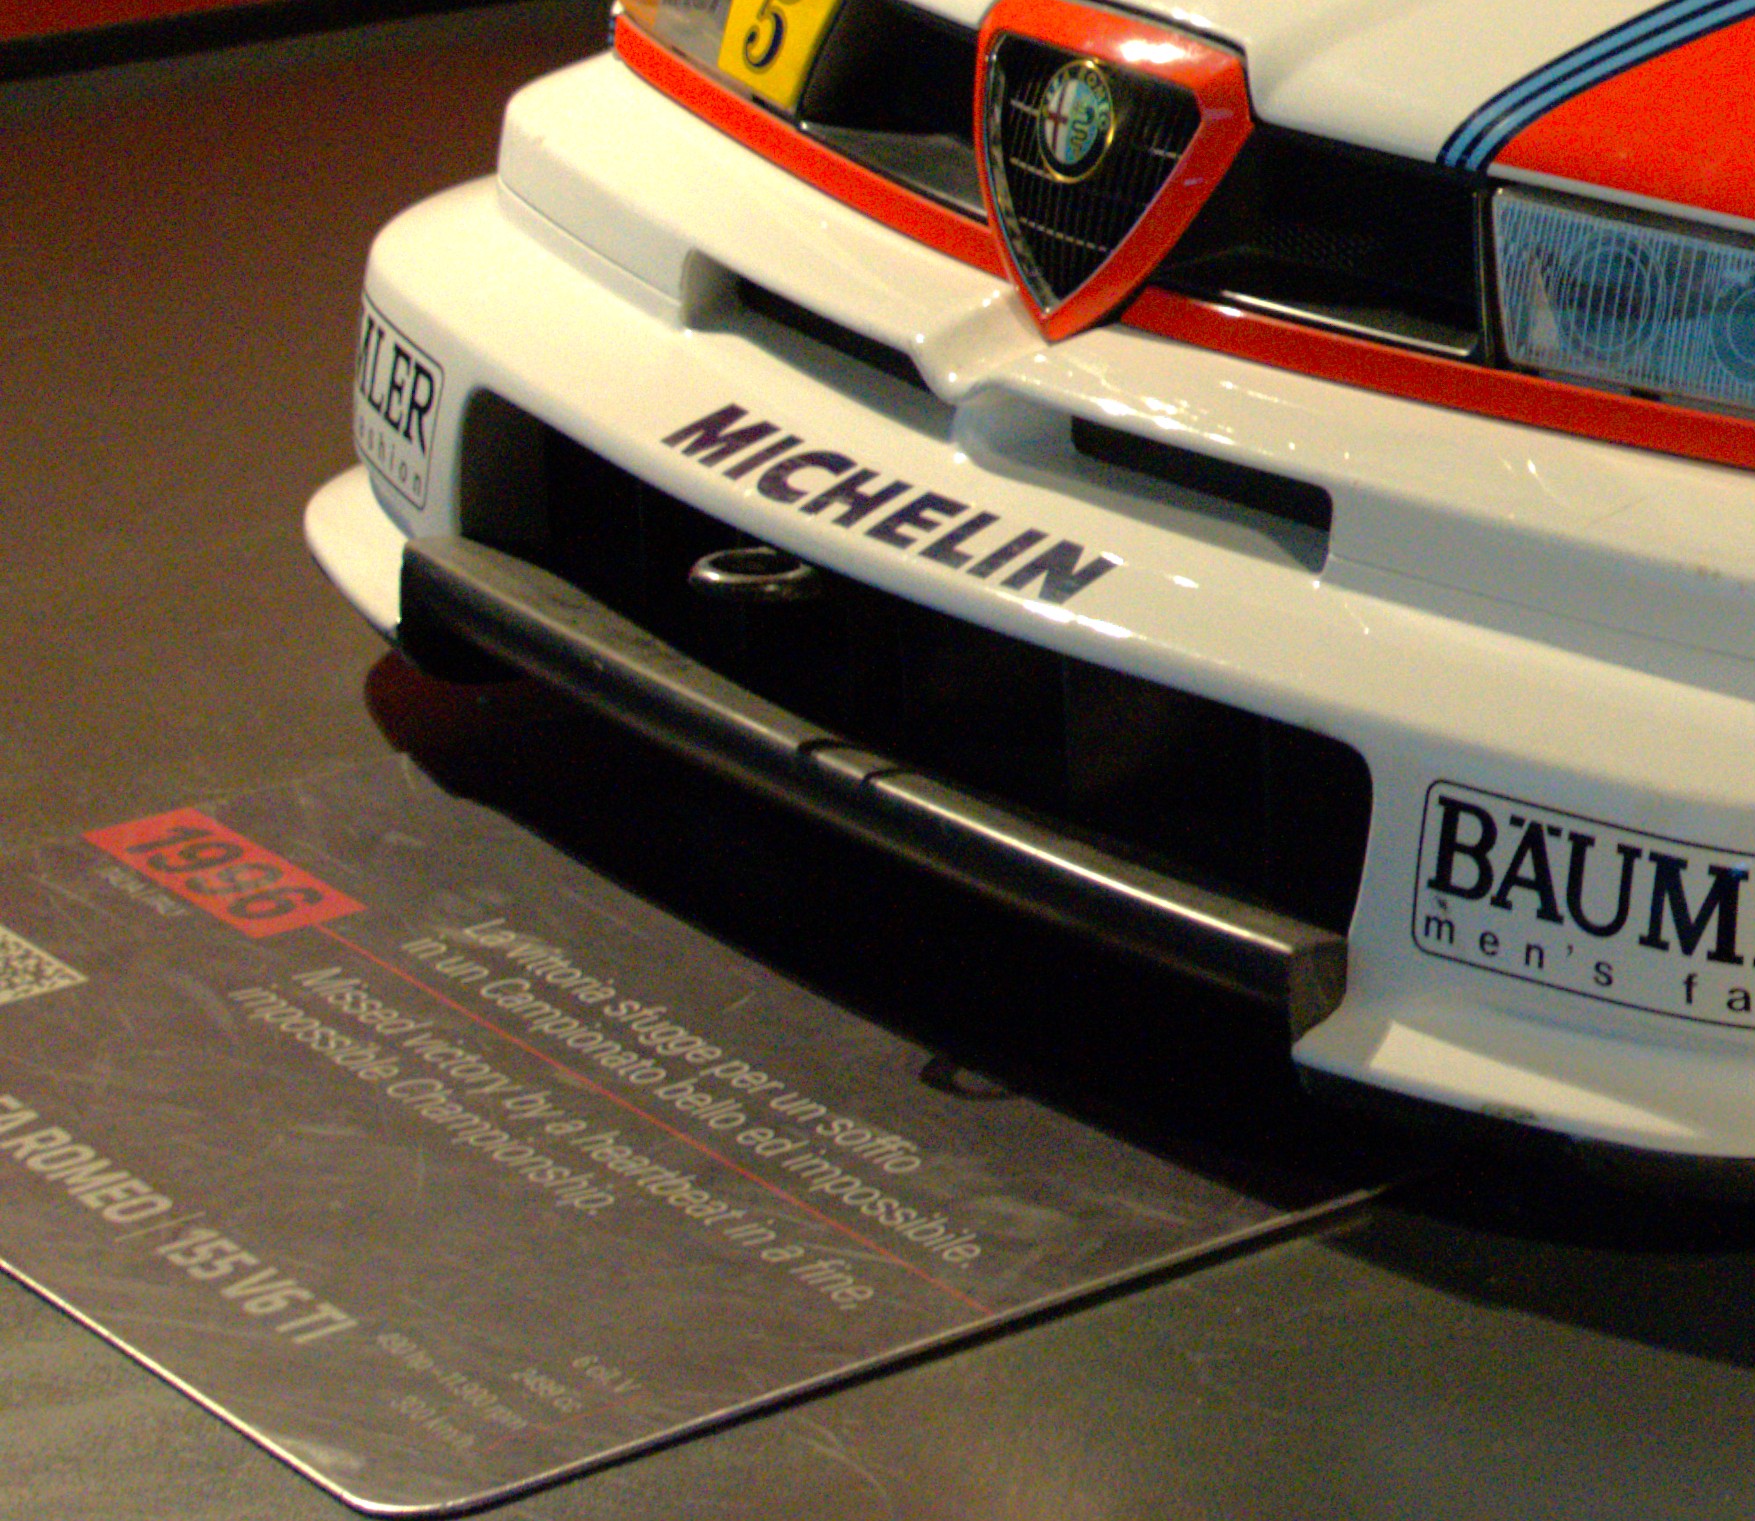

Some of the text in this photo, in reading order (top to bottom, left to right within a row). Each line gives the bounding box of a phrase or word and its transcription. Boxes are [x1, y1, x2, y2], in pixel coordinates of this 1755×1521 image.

[662, 404, 1127, 604] MICHELIN
[126, 824, 328, 922] 1996
[1422, 909, 1616, 988] men's
[227, 984, 616, 1215] impossible Championship.
[292, 964, 417, 1037] Missed
[402, 1024, 511, 1098] victory
[503, 1087, 565, 1126] by
[550, 1114, 588, 1138] a
[578, 1129, 747, 1227] heartbeat
[725, 1218, 778, 1249] in
[760, 1242, 805, 1266] a
[402, 931, 983, 1270] in un Campionato bello ed impossibile.
[463, 917, 923, 1176] La vittoria sfugge per un soffio
[0, 1126, 359, 1345] ROMEO 155 V6 TI
